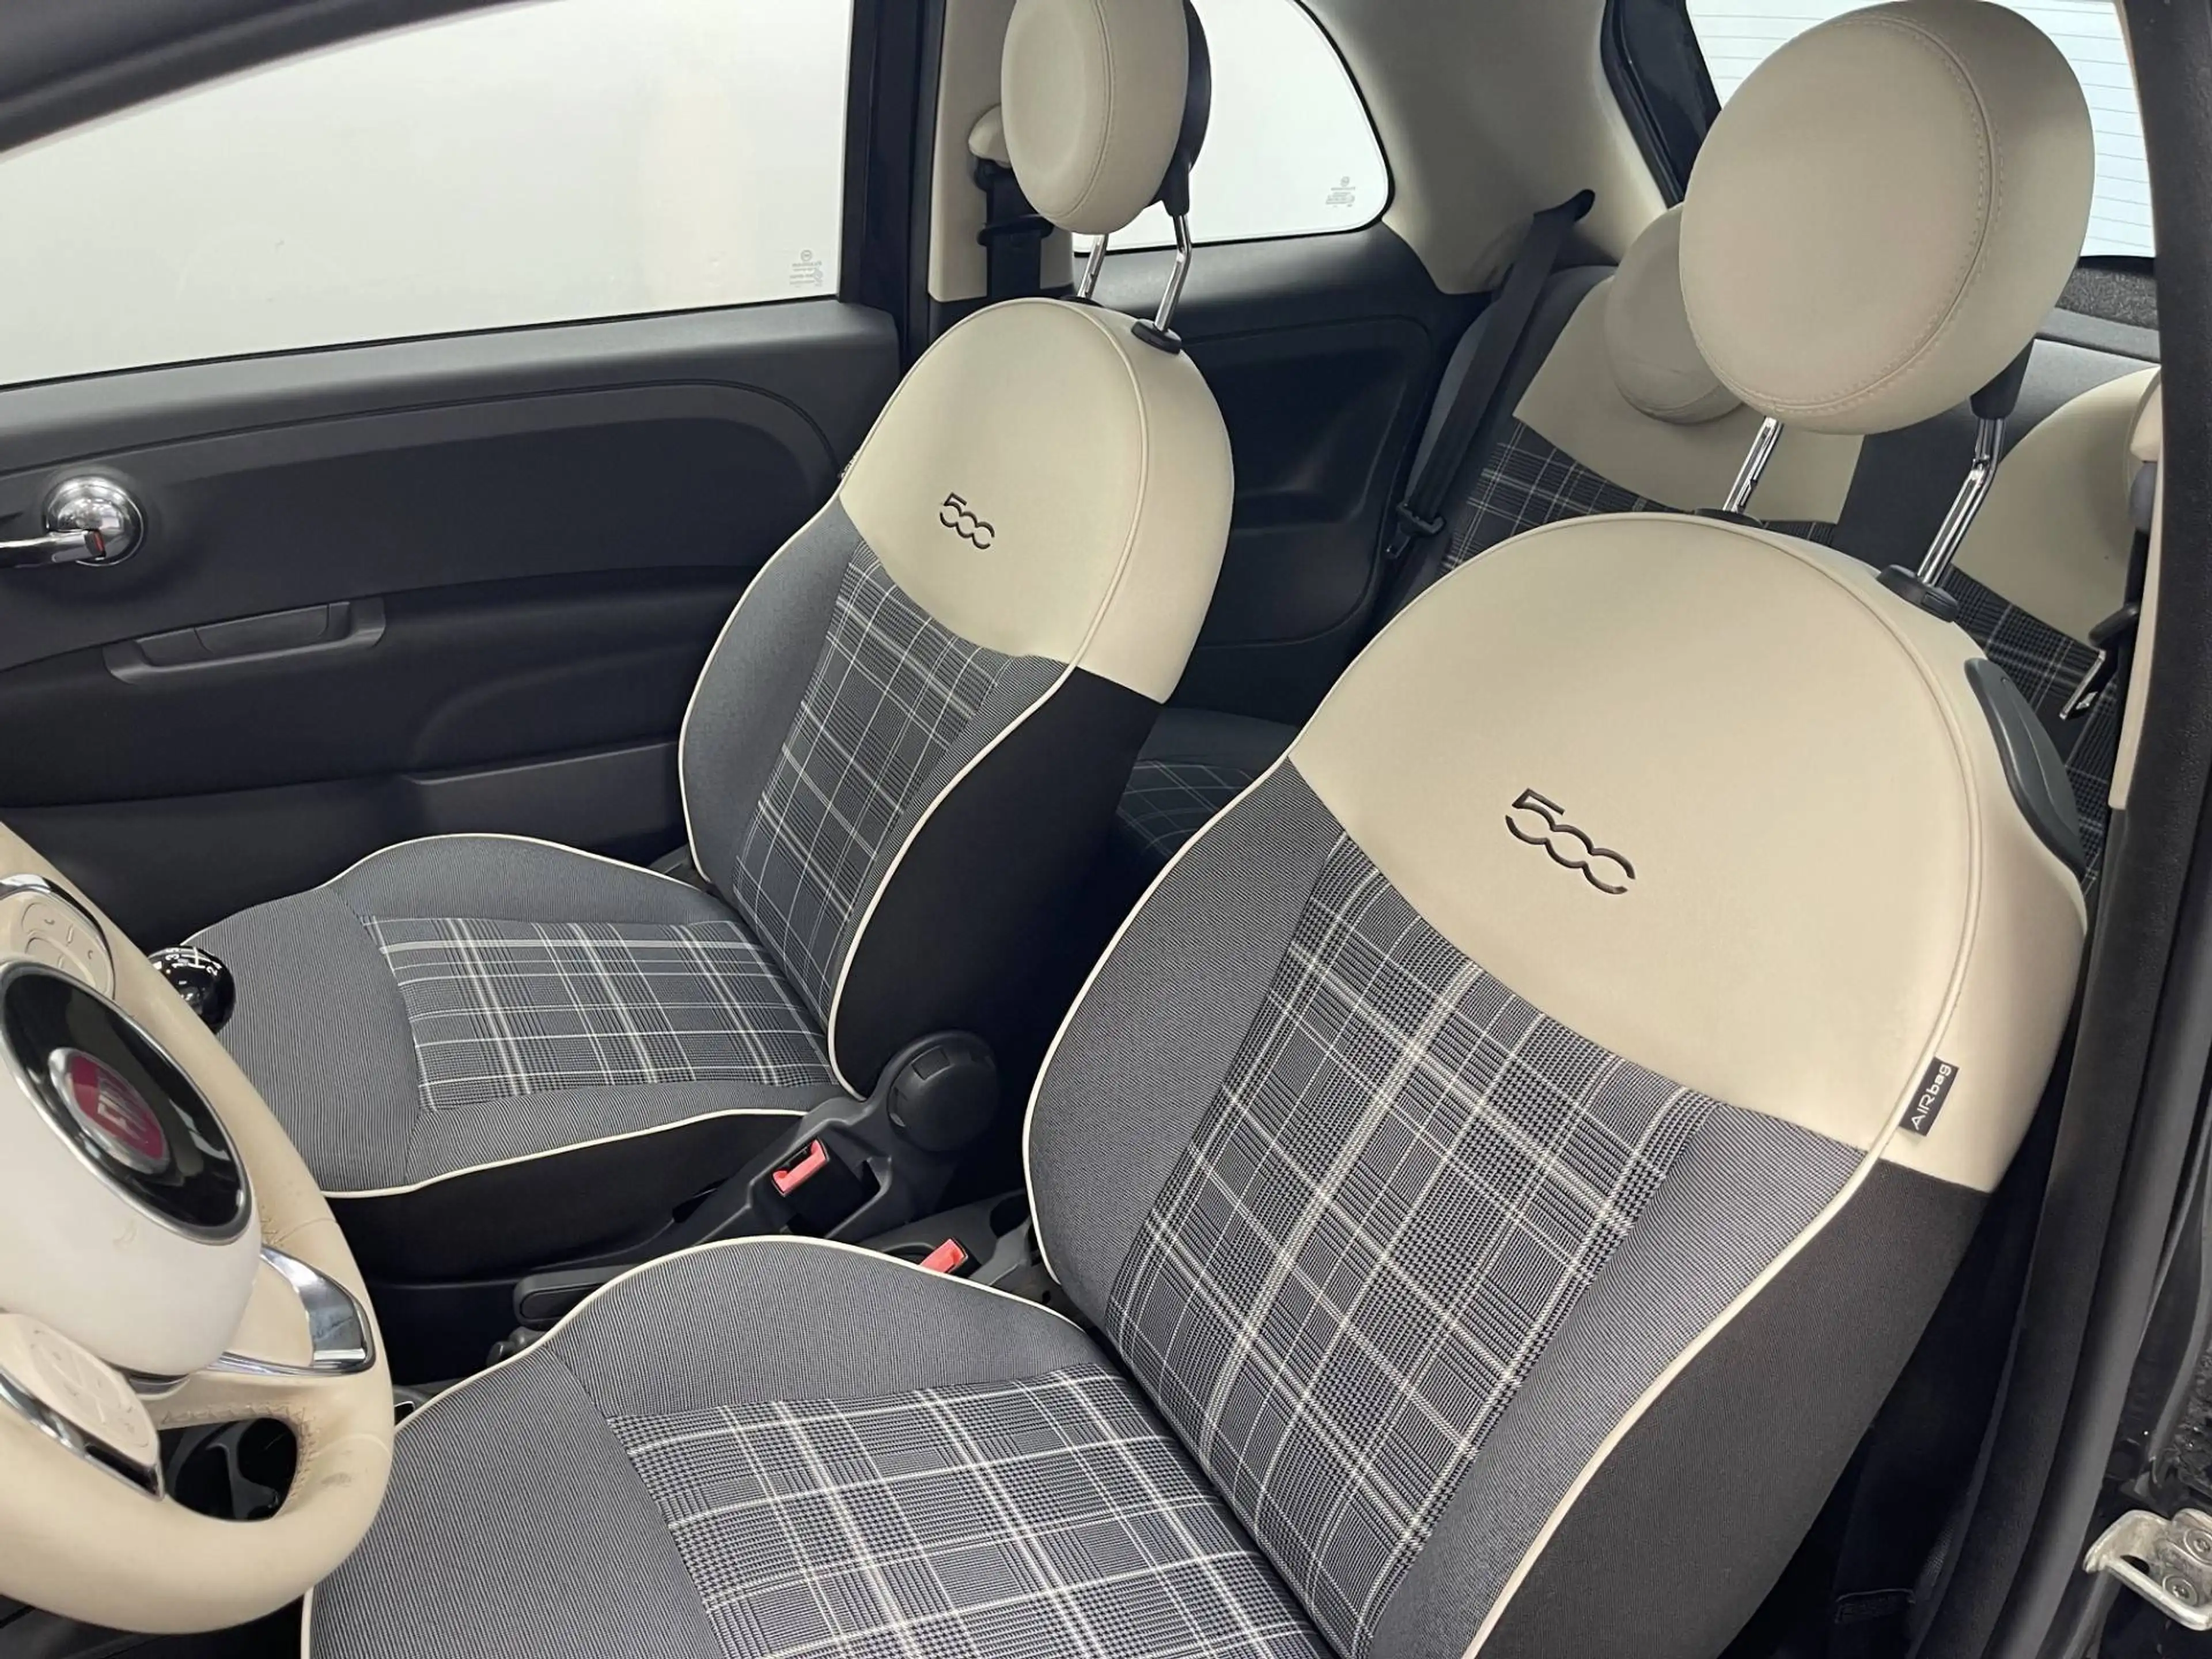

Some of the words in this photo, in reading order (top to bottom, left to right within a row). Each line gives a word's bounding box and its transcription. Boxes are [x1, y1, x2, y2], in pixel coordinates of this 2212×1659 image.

[940, 492, 995, 550] 500
[1505, 788, 1635, 894] 500
[206, 966, 218, 976] 2
[1911, 1064, 1952, 1131] AIRbag
